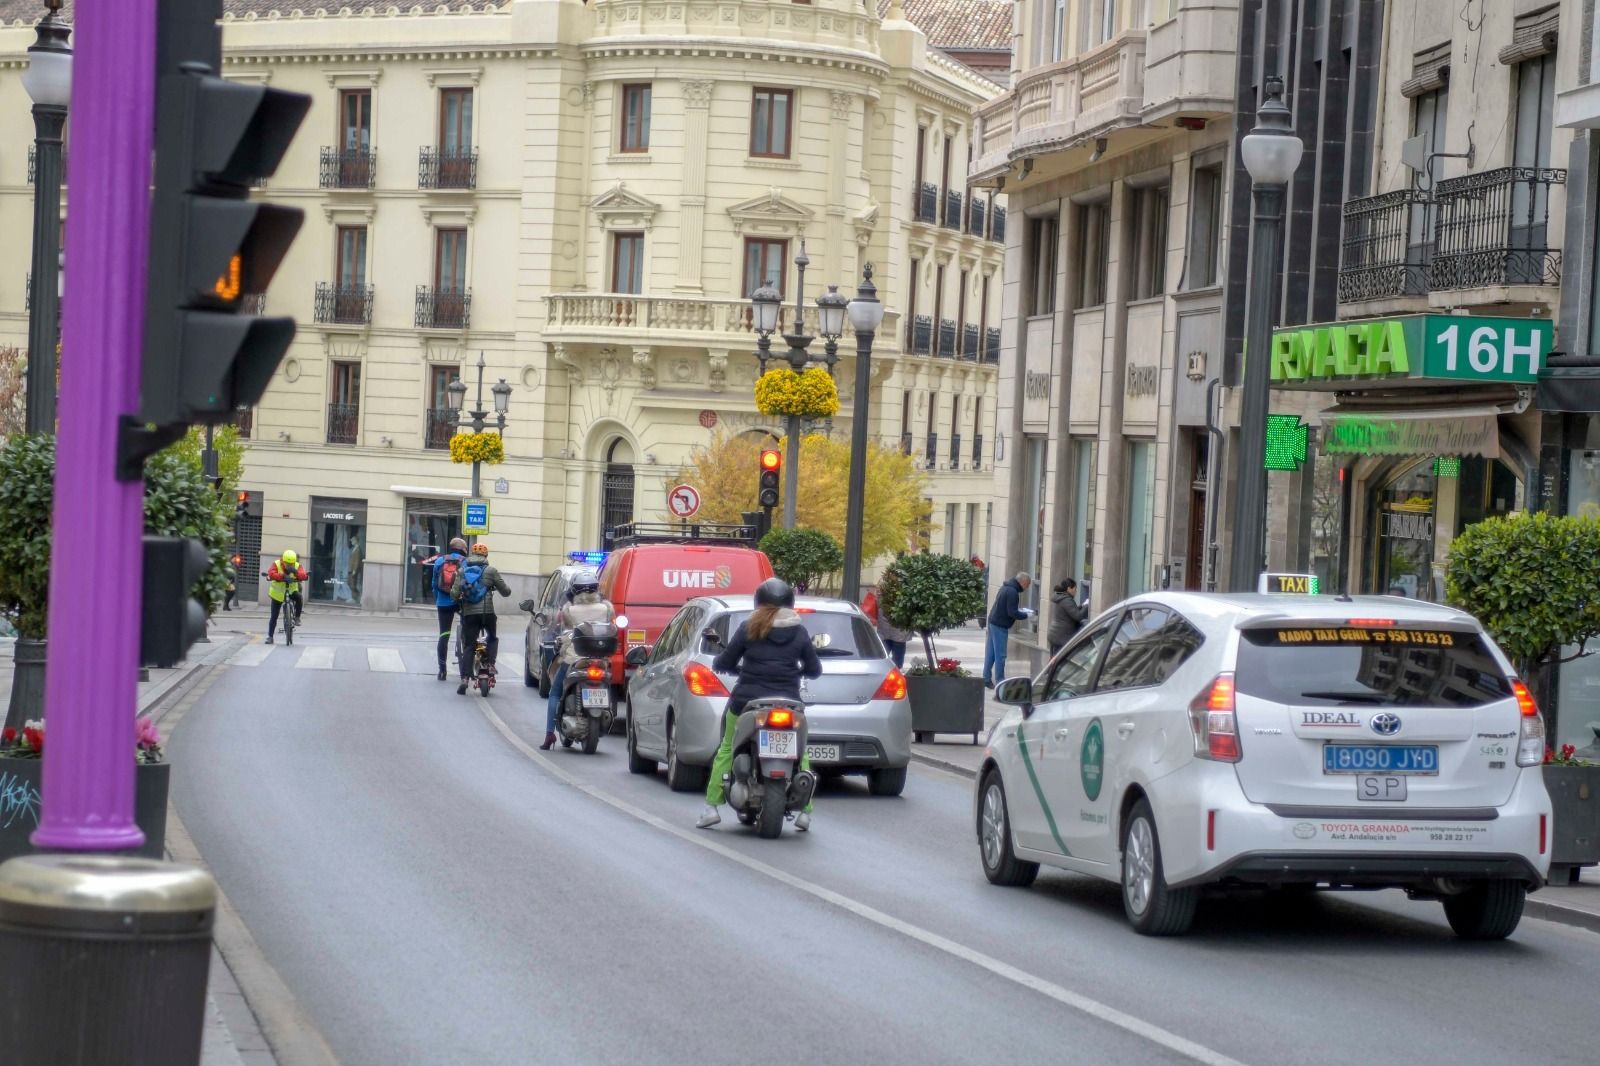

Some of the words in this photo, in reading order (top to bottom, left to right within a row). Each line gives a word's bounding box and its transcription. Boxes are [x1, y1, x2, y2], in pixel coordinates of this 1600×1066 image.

[1271, 321, 1409, 380] RMACIA
[1437, 325, 1541, 374] 16H
[1390, 514, 1433, 540] FARMAC
[663, 571, 715, 588] UME
[1278, 577, 1308, 593] TAXI
[1278, 631, 1312, 643] RADIO
[1313, 630, 1338, 641] TAXI
[1340, 629, 1370, 641] GENIL
[1388, 630, 1408, 642] 958
[1410, 631, 1423, 643] 13
[1424, 632, 1438, 644] 23
[1439, 633, 1453, 646] 23
[1302, 712, 1360, 724] IDEAL
[1339, 749, 1390, 768] 8090
[1397, 749, 1434, 768] JYD
[1321, 823, 1360, 832] TOYOTA
[1362, 824, 1410, 833] GRANADA
[1430, 833, 1443, 841] 958
